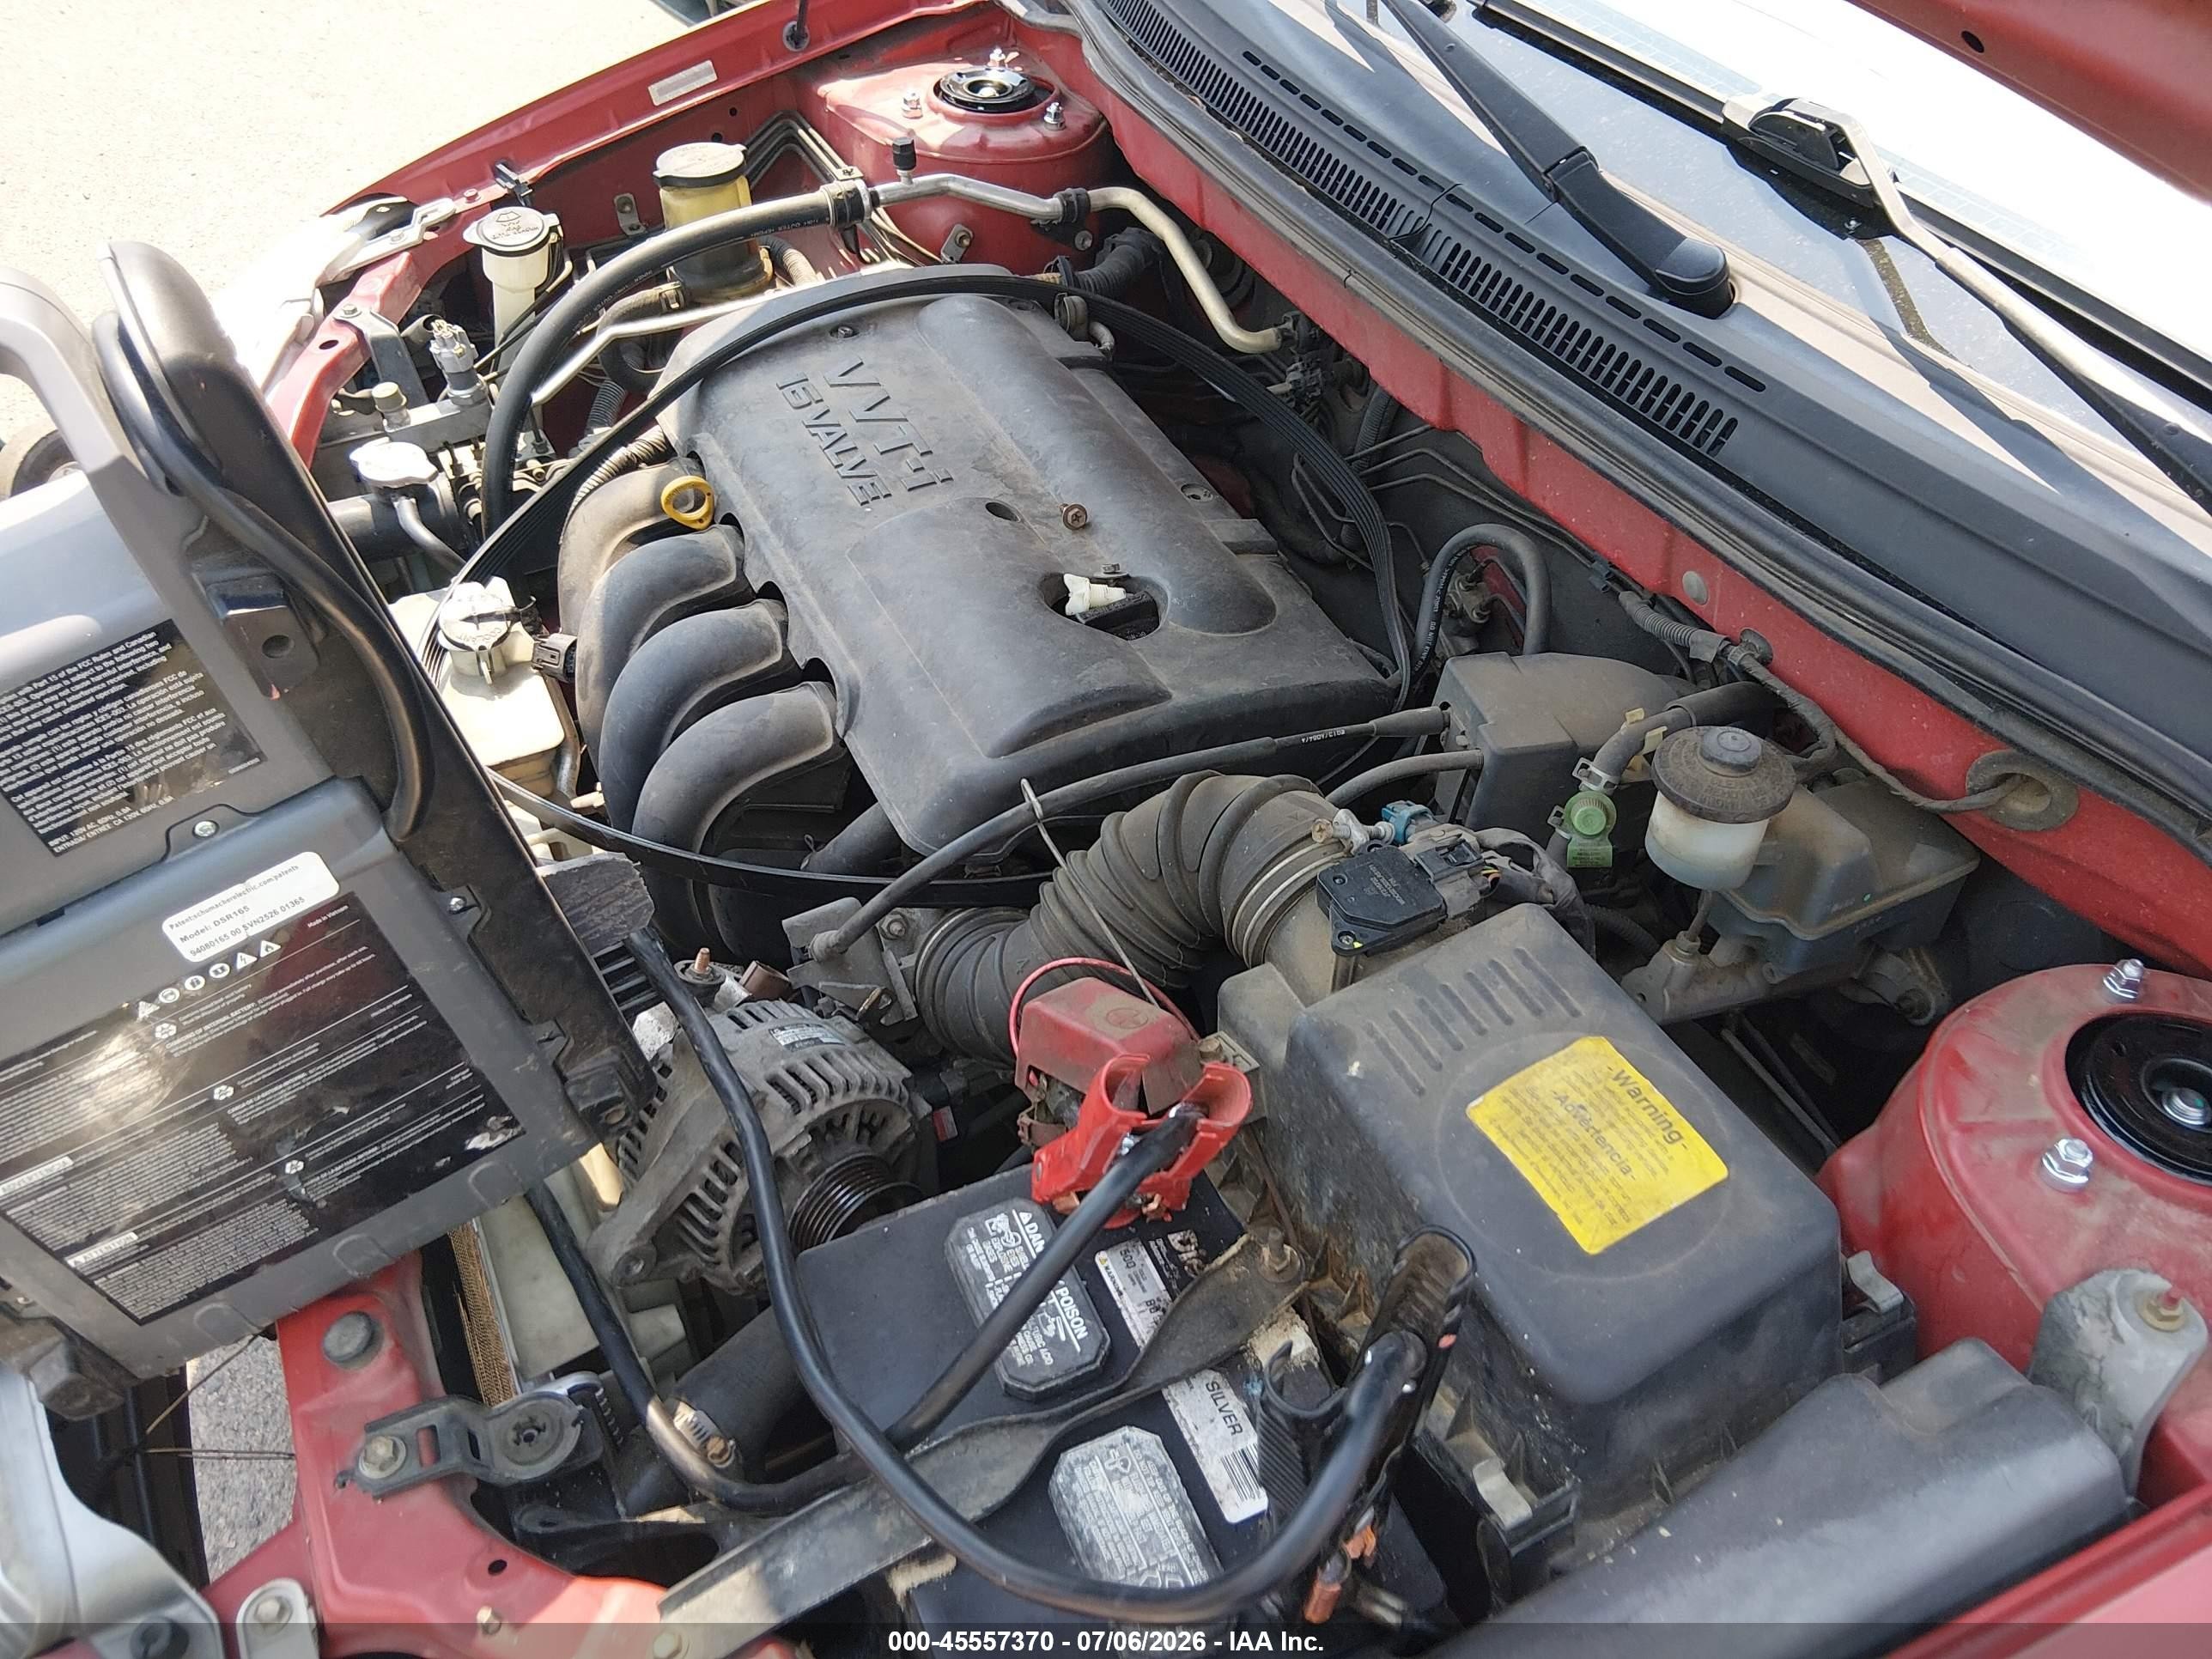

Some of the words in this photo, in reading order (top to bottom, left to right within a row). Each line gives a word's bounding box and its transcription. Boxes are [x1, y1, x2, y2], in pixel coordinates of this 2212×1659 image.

[802, 405, 892, 507] VALVE
[1425, 631, 1434, 645] NOT
[28, 681, 64, 701] Operation
[102, 659, 116, 669] the
[113, 645, 146, 663] following
[143, 639, 160, 649] two
[32, 678, 49, 690] Part
[47, 674, 58, 683] 15
[77, 659, 94, 670] FCC
[111, 645, 126, 654] and
[125, 630, 156, 648] Canadian
[90, 667, 119, 684] harmful
[116, 648, 159, 672] interference,
[156, 642, 173, 653] and
[105, 668, 137, 687] received,
[135, 654, 167, 672] including
[162, 674, 179, 684] FCC
[126, 702, 137, 710] La
[181, 715, 198, 726] FCC
[179, 923, 211, 943] Model:
[211, 904, 251, 927] DSR165
[189, 933, 230, 957] 94080165
[229, 927, 242, 937] 00
[240, 908, 280, 931] SVN2526
[278, 896, 306, 912] 01365
[981, 1238, 999, 1264] GASES
[990, 1235, 1013, 1273] EXPLOSIVE
[1013, 1244, 1031, 1271] SHIEL
[1119, 1247, 1136, 1270] 500
[1054, 1285, 1090, 1340] POISON
[1024, 1315, 1046, 1348] LFURIC
[1038, 1346, 1054, 1366] ACID
[1204, 1377, 1243, 1438] SILVER
